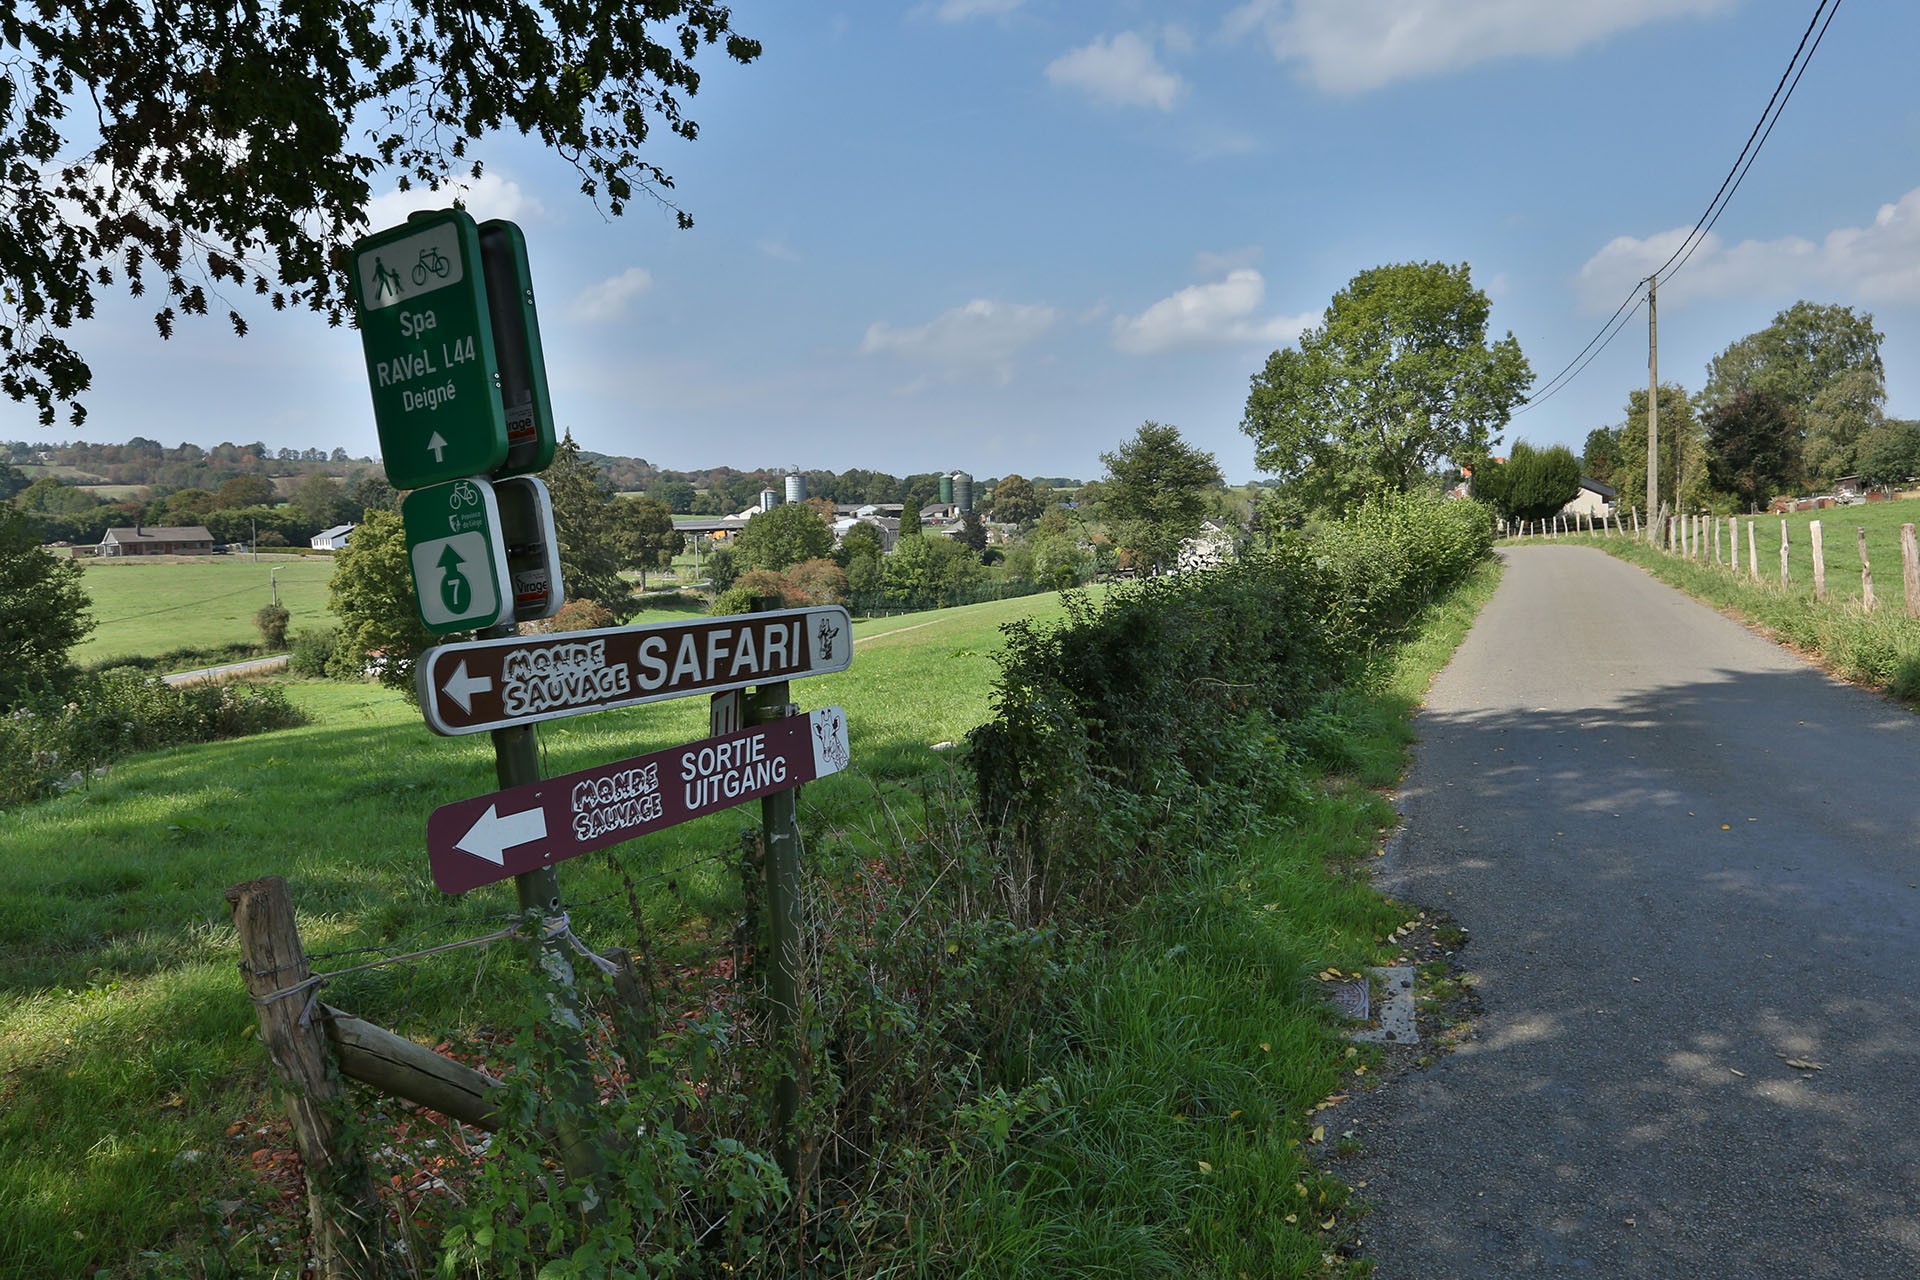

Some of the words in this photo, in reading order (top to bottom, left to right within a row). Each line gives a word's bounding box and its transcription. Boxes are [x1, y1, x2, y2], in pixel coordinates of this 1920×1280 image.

[400, 310, 436, 338] Spa
[377, 350, 436, 387] RAVeL
[443, 336, 475, 368] L44
[403, 379, 456, 412] Deigné
[448, 579, 460, 605] 7
[502, 639, 606, 683] MONDE
[636, 621, 801, 691] SAFARI
[503, 664, 630, 716] SAUVAGE
[681, 733, 766, 781] SORTIE
[572, 763, 659, 812] MONDE
[685, 756, 787, 811] UITGANG
[573, 794, 662, 842] SAUVAGE
